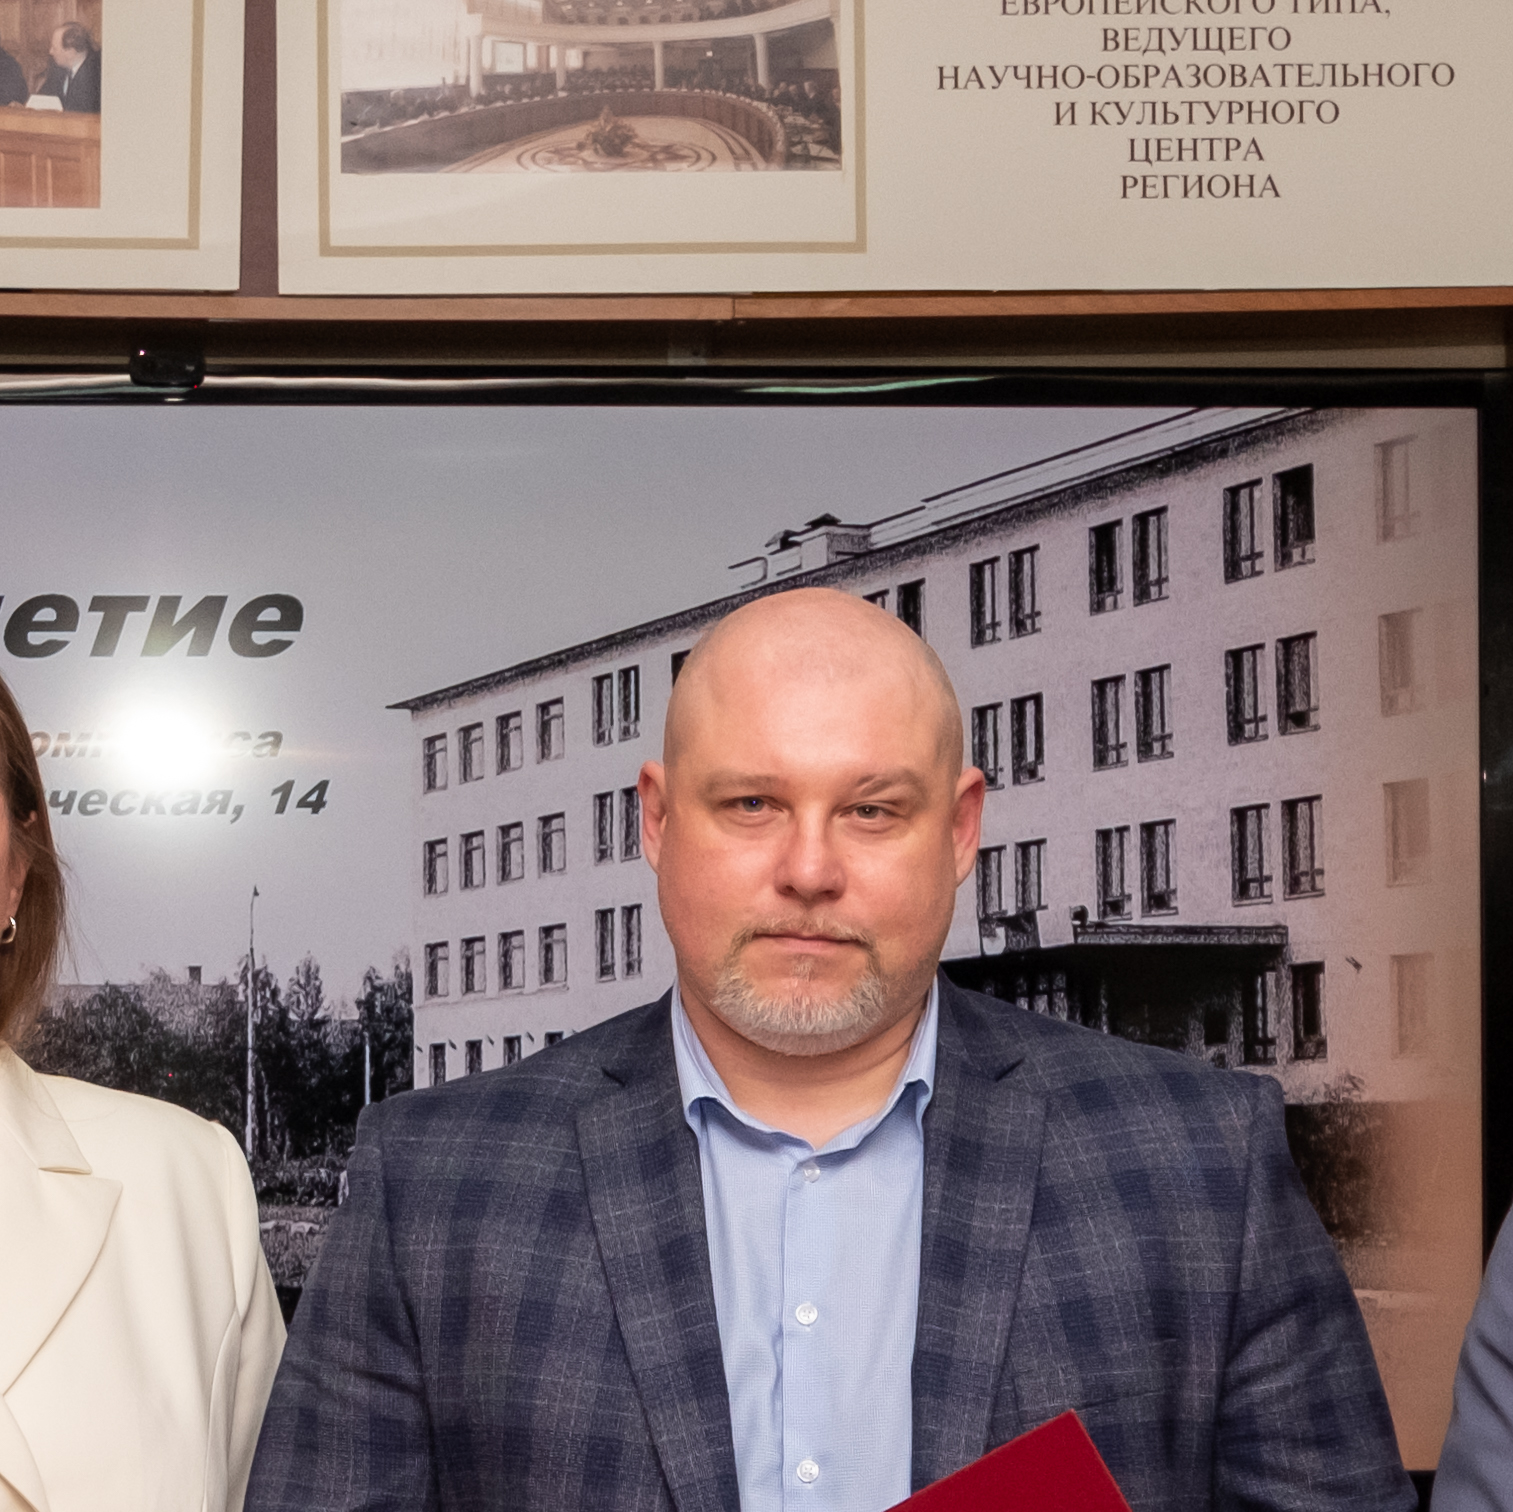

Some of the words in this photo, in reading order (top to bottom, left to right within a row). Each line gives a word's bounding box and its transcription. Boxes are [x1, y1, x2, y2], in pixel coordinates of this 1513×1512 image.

[1100, 26, 1292, 55] ВЕДУЩЕГО
[937, 62, 1456, 92] НАУЧНО-ОБРАЗОВАТЕЛЬНОГО
[1054, 102, 1078, 126] И
[1089, 100, 1341, 127] КУЛЬТУРНОГО
[1127, 136, 1266, 166] ЦЕНТРА
[1121, 173, 1282, 200] РЕГИОНА
[270, 778, 330, 817] 14
